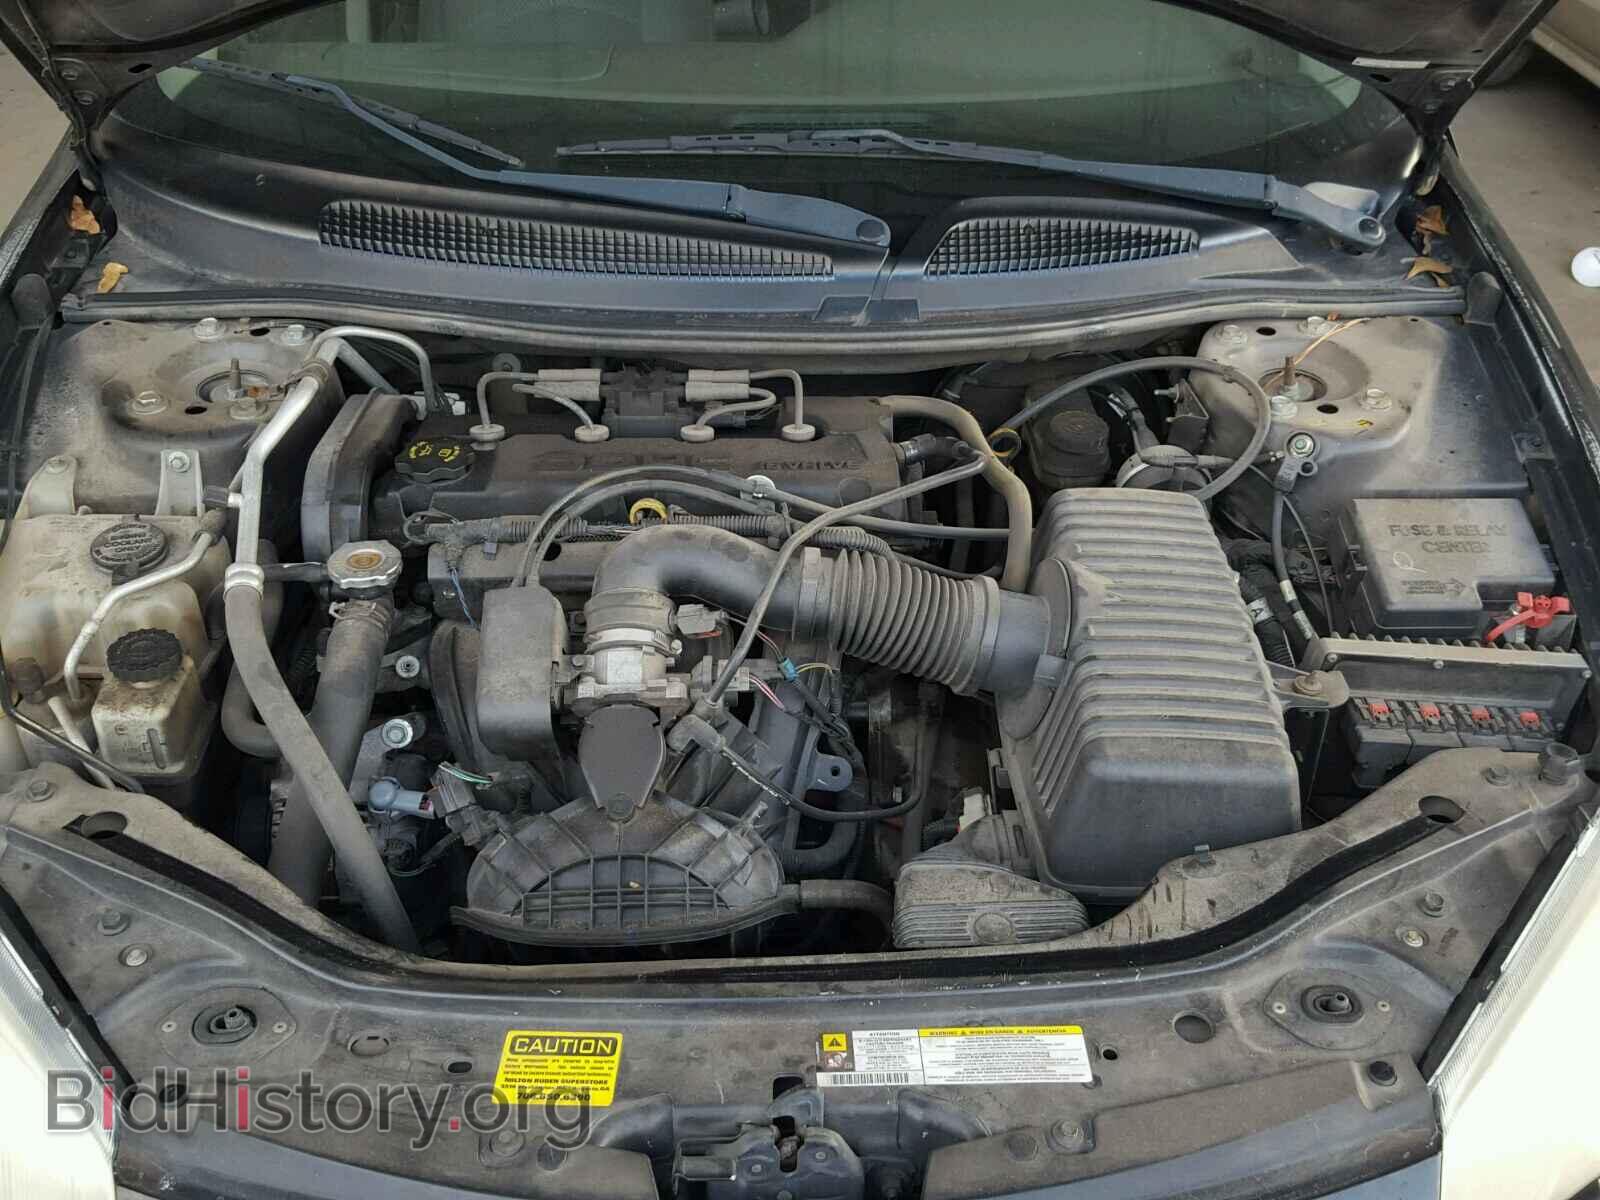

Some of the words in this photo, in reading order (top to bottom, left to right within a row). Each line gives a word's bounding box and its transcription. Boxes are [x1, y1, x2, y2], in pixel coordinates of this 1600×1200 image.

[1388, 524, 1432, 537] FUSE
[1453, 523, 1508, 537] RELAY
[1421, 540, 1493, 553] CENTER
[514, 1037, 613, 1055] CAUTION
